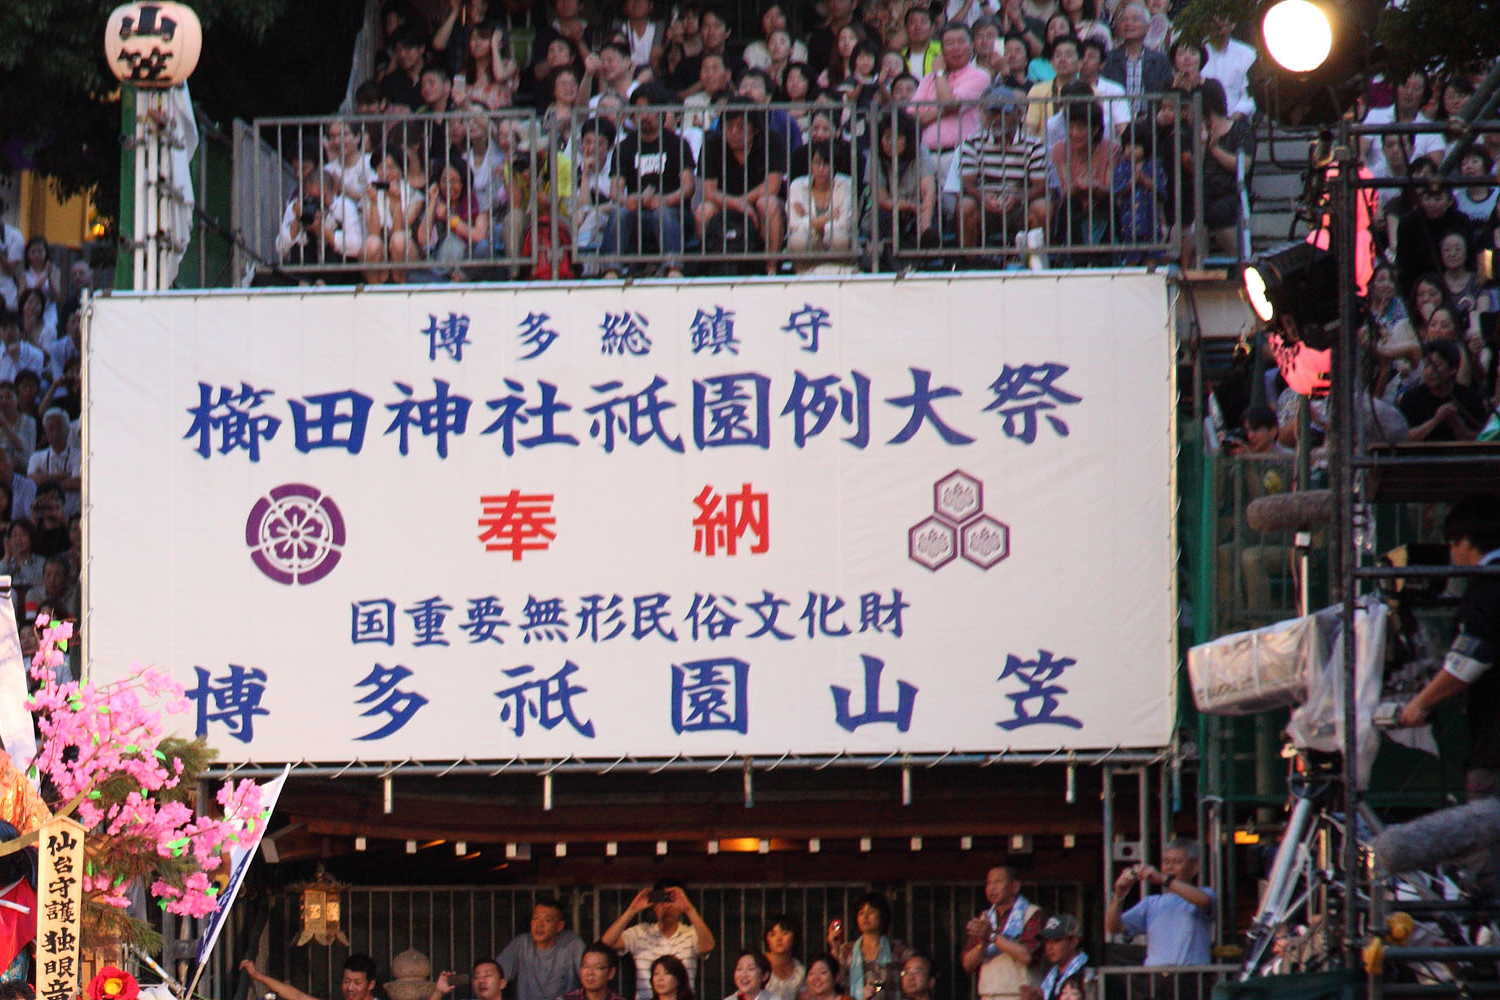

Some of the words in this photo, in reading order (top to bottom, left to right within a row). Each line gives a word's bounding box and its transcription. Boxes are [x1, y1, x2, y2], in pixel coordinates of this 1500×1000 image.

[422, 304, 832, 362] 博多総鎮守
[184, 361, 1082, 462] 櫛田神社祇園例大祭
[478, 484, 770, 561] 奉納
[350, 588, 910, 646] 国重要無形民俗文化財
[186, 649, 1083, 743] 博多祇園山笠
